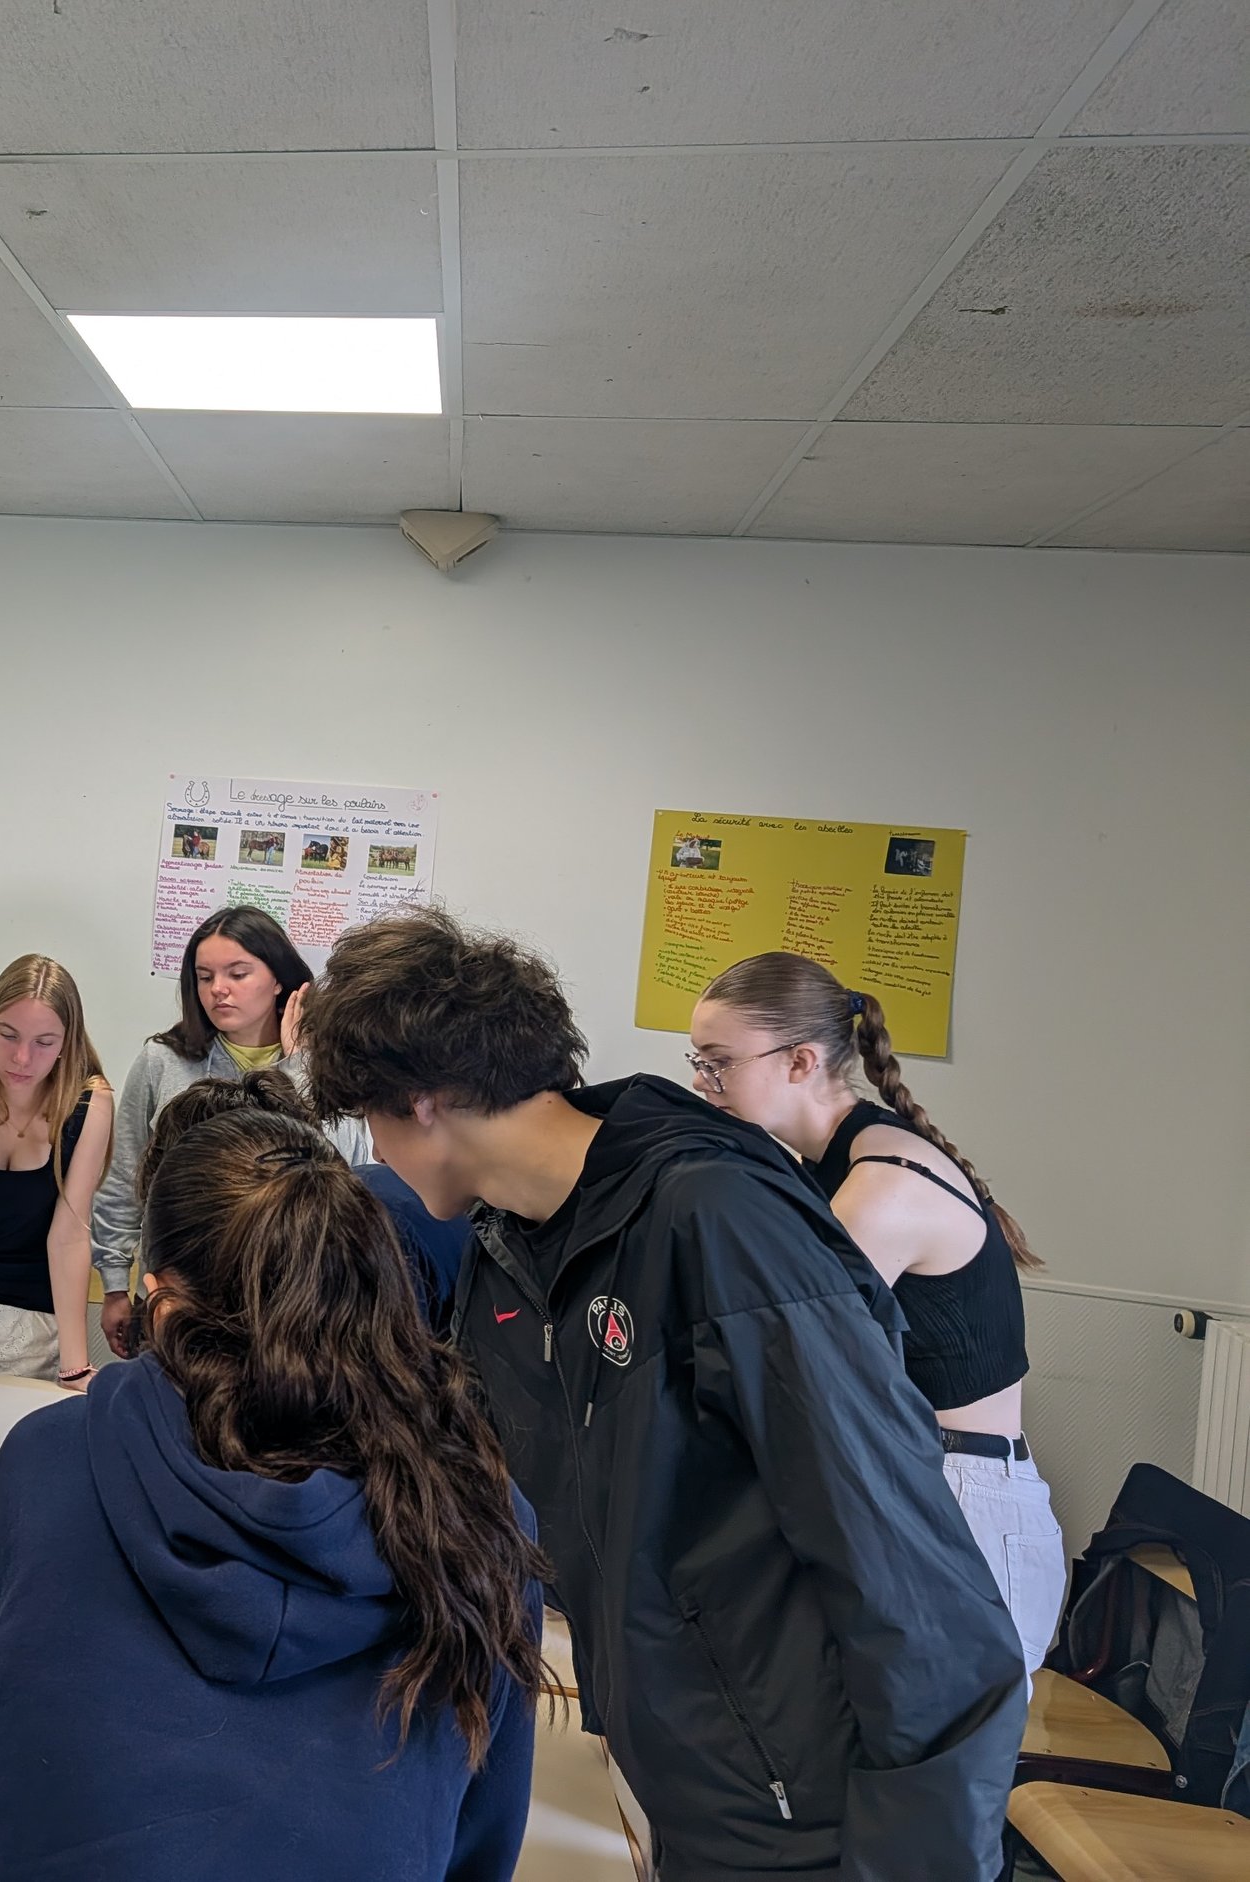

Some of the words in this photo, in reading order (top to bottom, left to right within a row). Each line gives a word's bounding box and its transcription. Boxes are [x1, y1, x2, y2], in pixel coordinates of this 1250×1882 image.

[230, 779, 246, 800] Le
[298, 795, 318, 805] sur
[322, 794, 338, 807] les
[344, 798, 386, 810] poulains
[692, 812, 708, 823] La
[712, 816, 752, 826] sécurité
[758, 821, 783, 829] avec
[794, 822, 807, 830] les
[818, 824, 854, 834] abeilles
